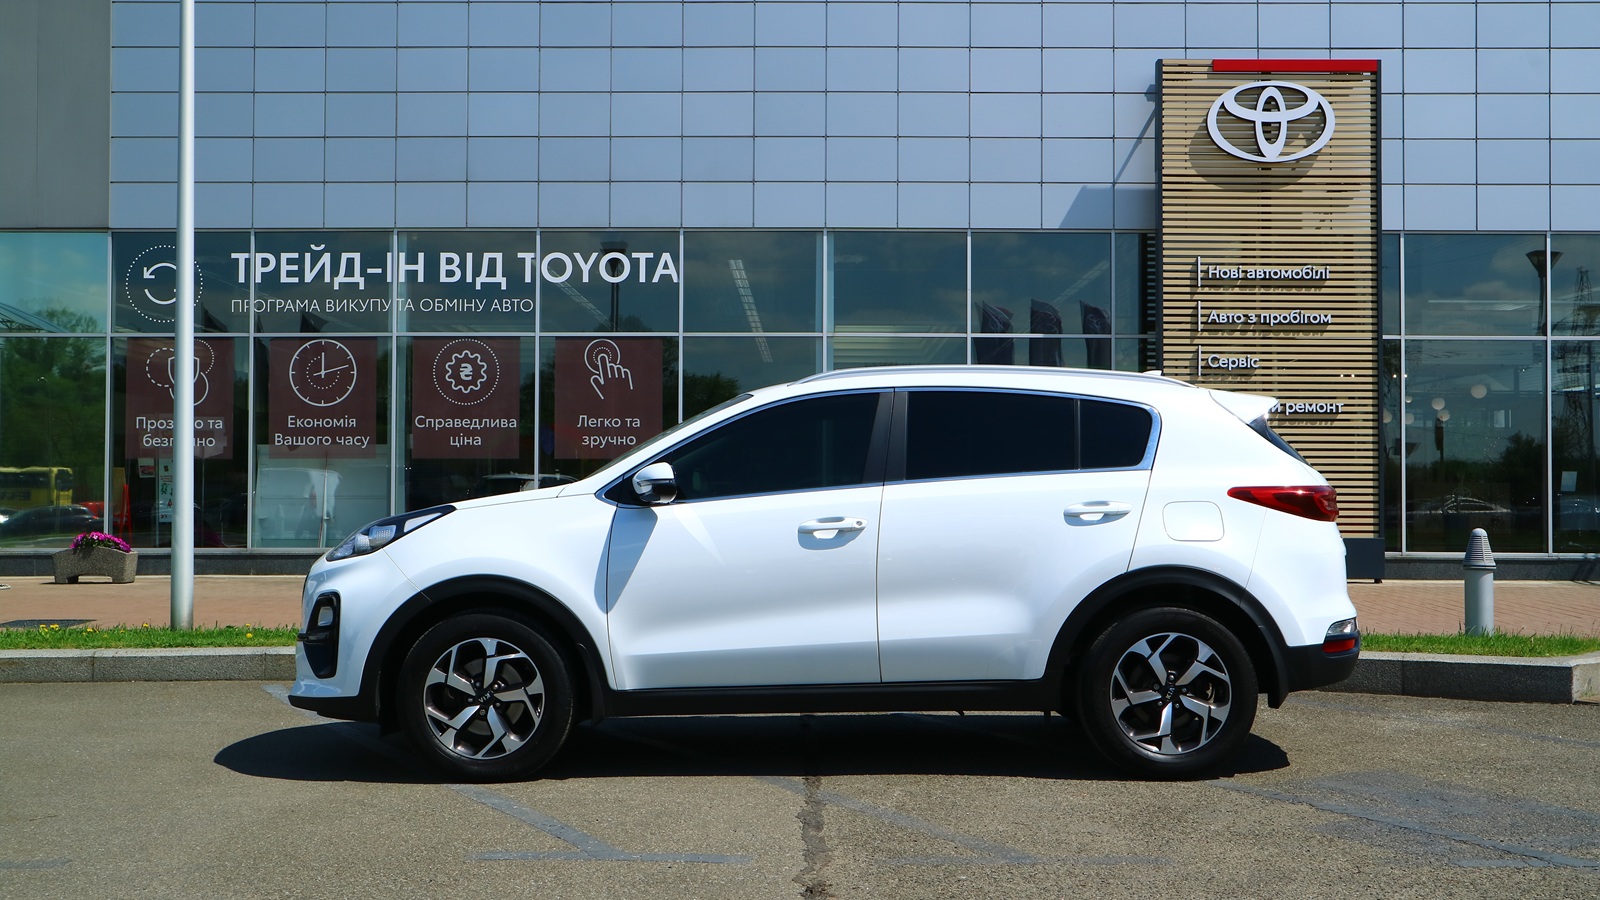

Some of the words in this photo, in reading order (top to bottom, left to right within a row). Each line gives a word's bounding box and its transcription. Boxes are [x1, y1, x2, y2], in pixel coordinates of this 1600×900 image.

[230, 243, 425, 291] ТРЕЙД-ІН
[439, 252, 507, 290] ВІД
[517, 252, 680, 284] TOYOTA
[1208, 265, 1242, 279] Нові
[1246, 265, 1330, 279] автомобілі
[231, 299, 321, 313] ПРОГРАМА
[325, 298, 391, 313] ВИКУПУ
[395, 298, 415, 312] ТА
[419, 298, 487, 313] ОБМІНУ
[490, 298, 534, 312] АВТО
[1208, 310, 1244, 324] Авто
[1247, 313, 1256, 324] з
[1260, 309, 1332, 326] пробігом
[1208, 354, 1260, 370] Сервіс
[1285, 402, 1344, 416] ремонт
[136, 416, 204, 432] Прозо
[208, 419, 223, 429] та
[287, 415, 357, 428] Економія
[414, 415, 517, 431] Справедлива
[577, 414, 621, 428] Легко
[625, 418, 641, 428] та
[274, 433, 332, 446] Вашого
[336, 436, 370, 448] часу
[450, 433, 482, 448] ціна
[581, 435, 637, 448] зручно
